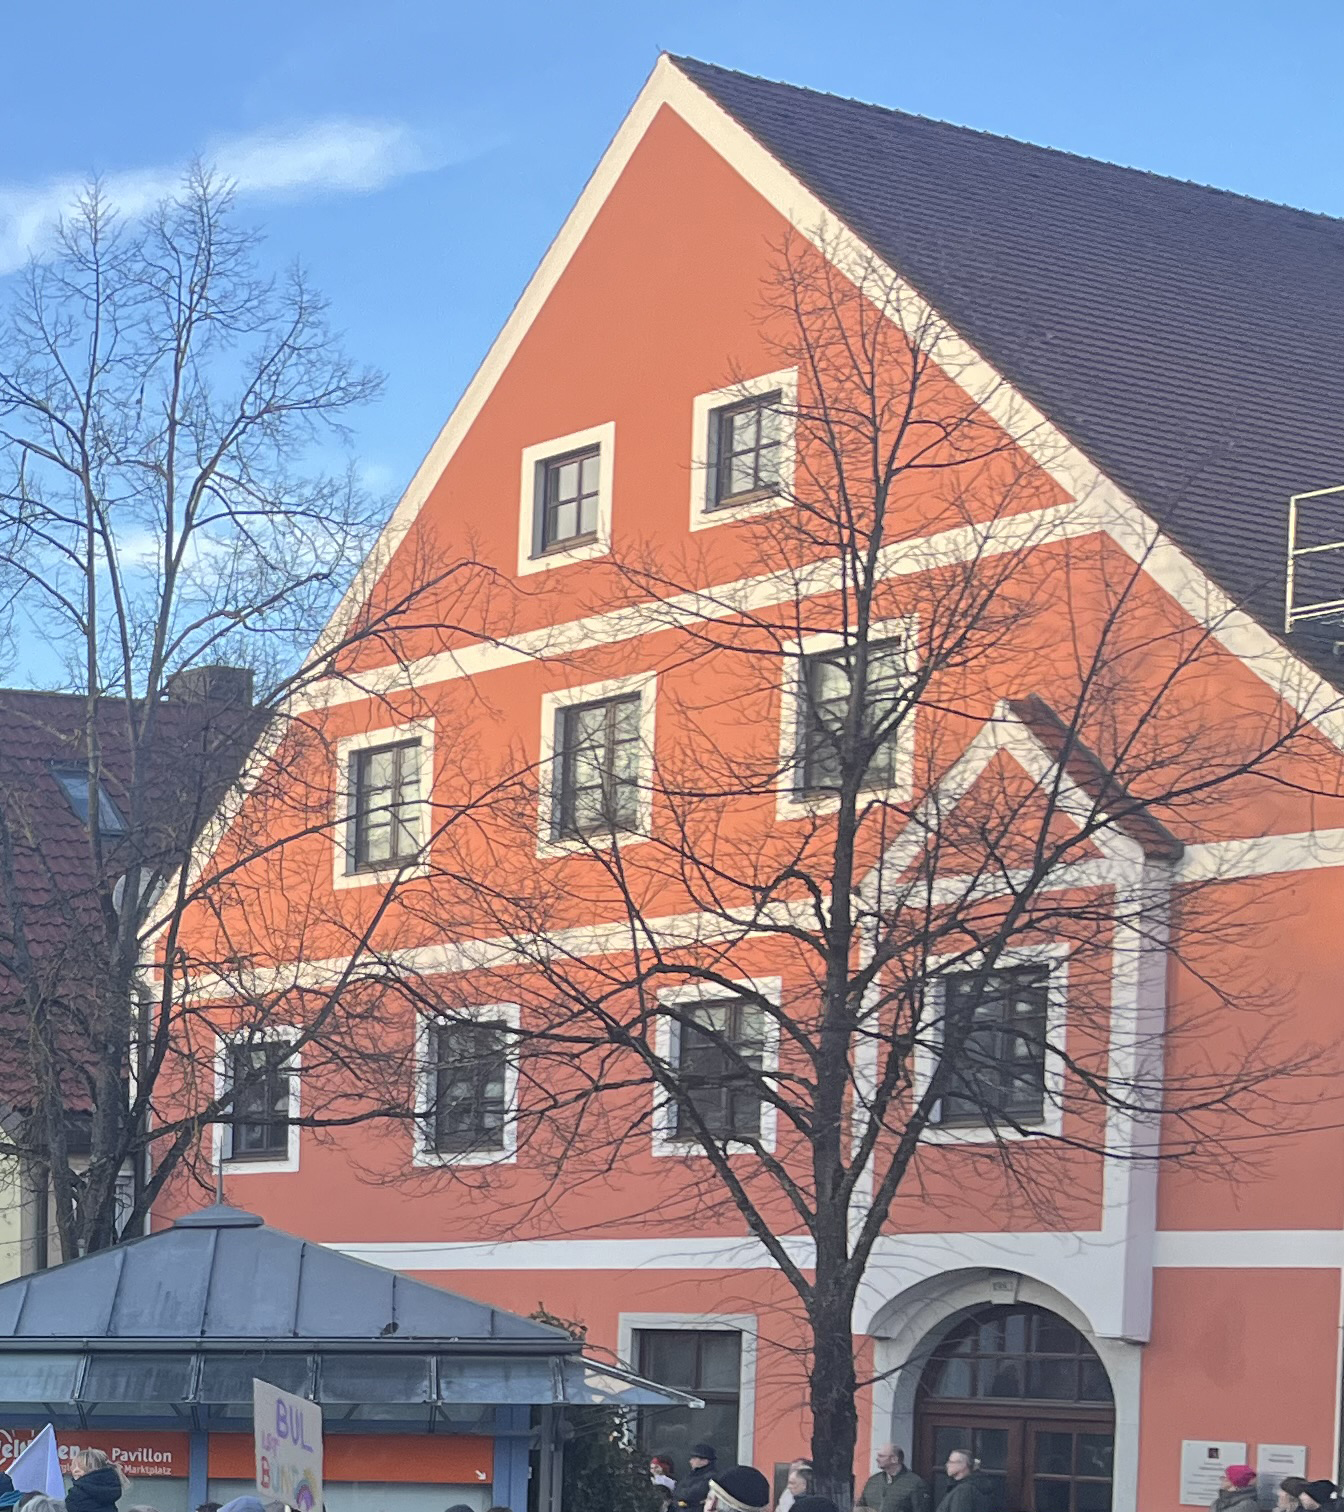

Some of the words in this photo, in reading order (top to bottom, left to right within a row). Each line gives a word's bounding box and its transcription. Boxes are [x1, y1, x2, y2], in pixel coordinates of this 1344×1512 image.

[276, 1398, 314, 1453] BUL
[112, 1447, 172, 1464] Pavillon
[124, 1465, 172, 1477] Marktplatz
